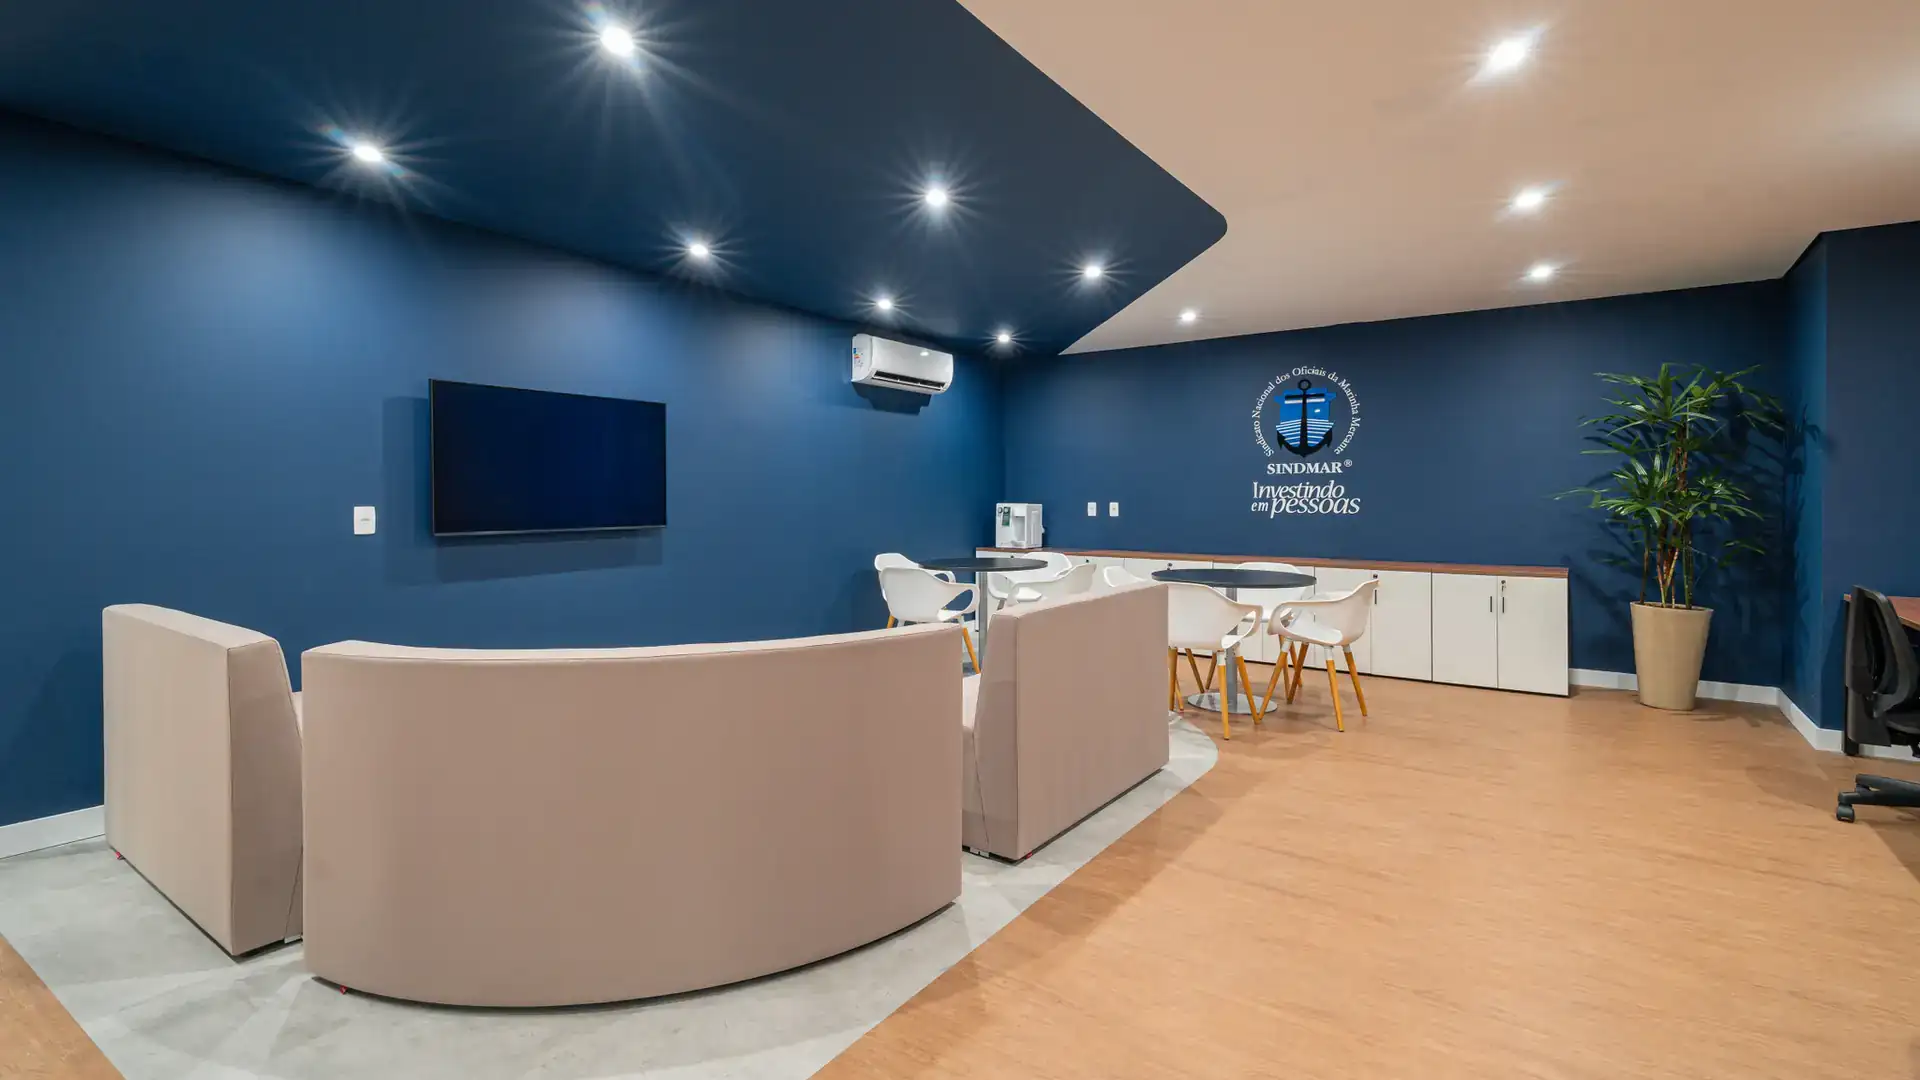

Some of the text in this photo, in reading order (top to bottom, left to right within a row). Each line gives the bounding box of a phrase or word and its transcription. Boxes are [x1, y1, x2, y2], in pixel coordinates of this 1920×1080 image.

[1252, 366, 1361, 457] Sindicato Nacional dos Oficiais da Marinha Mercante
[1253, 480, 1345, 499] Investindo
[1251, 496, 1361, 519] em pessoas
